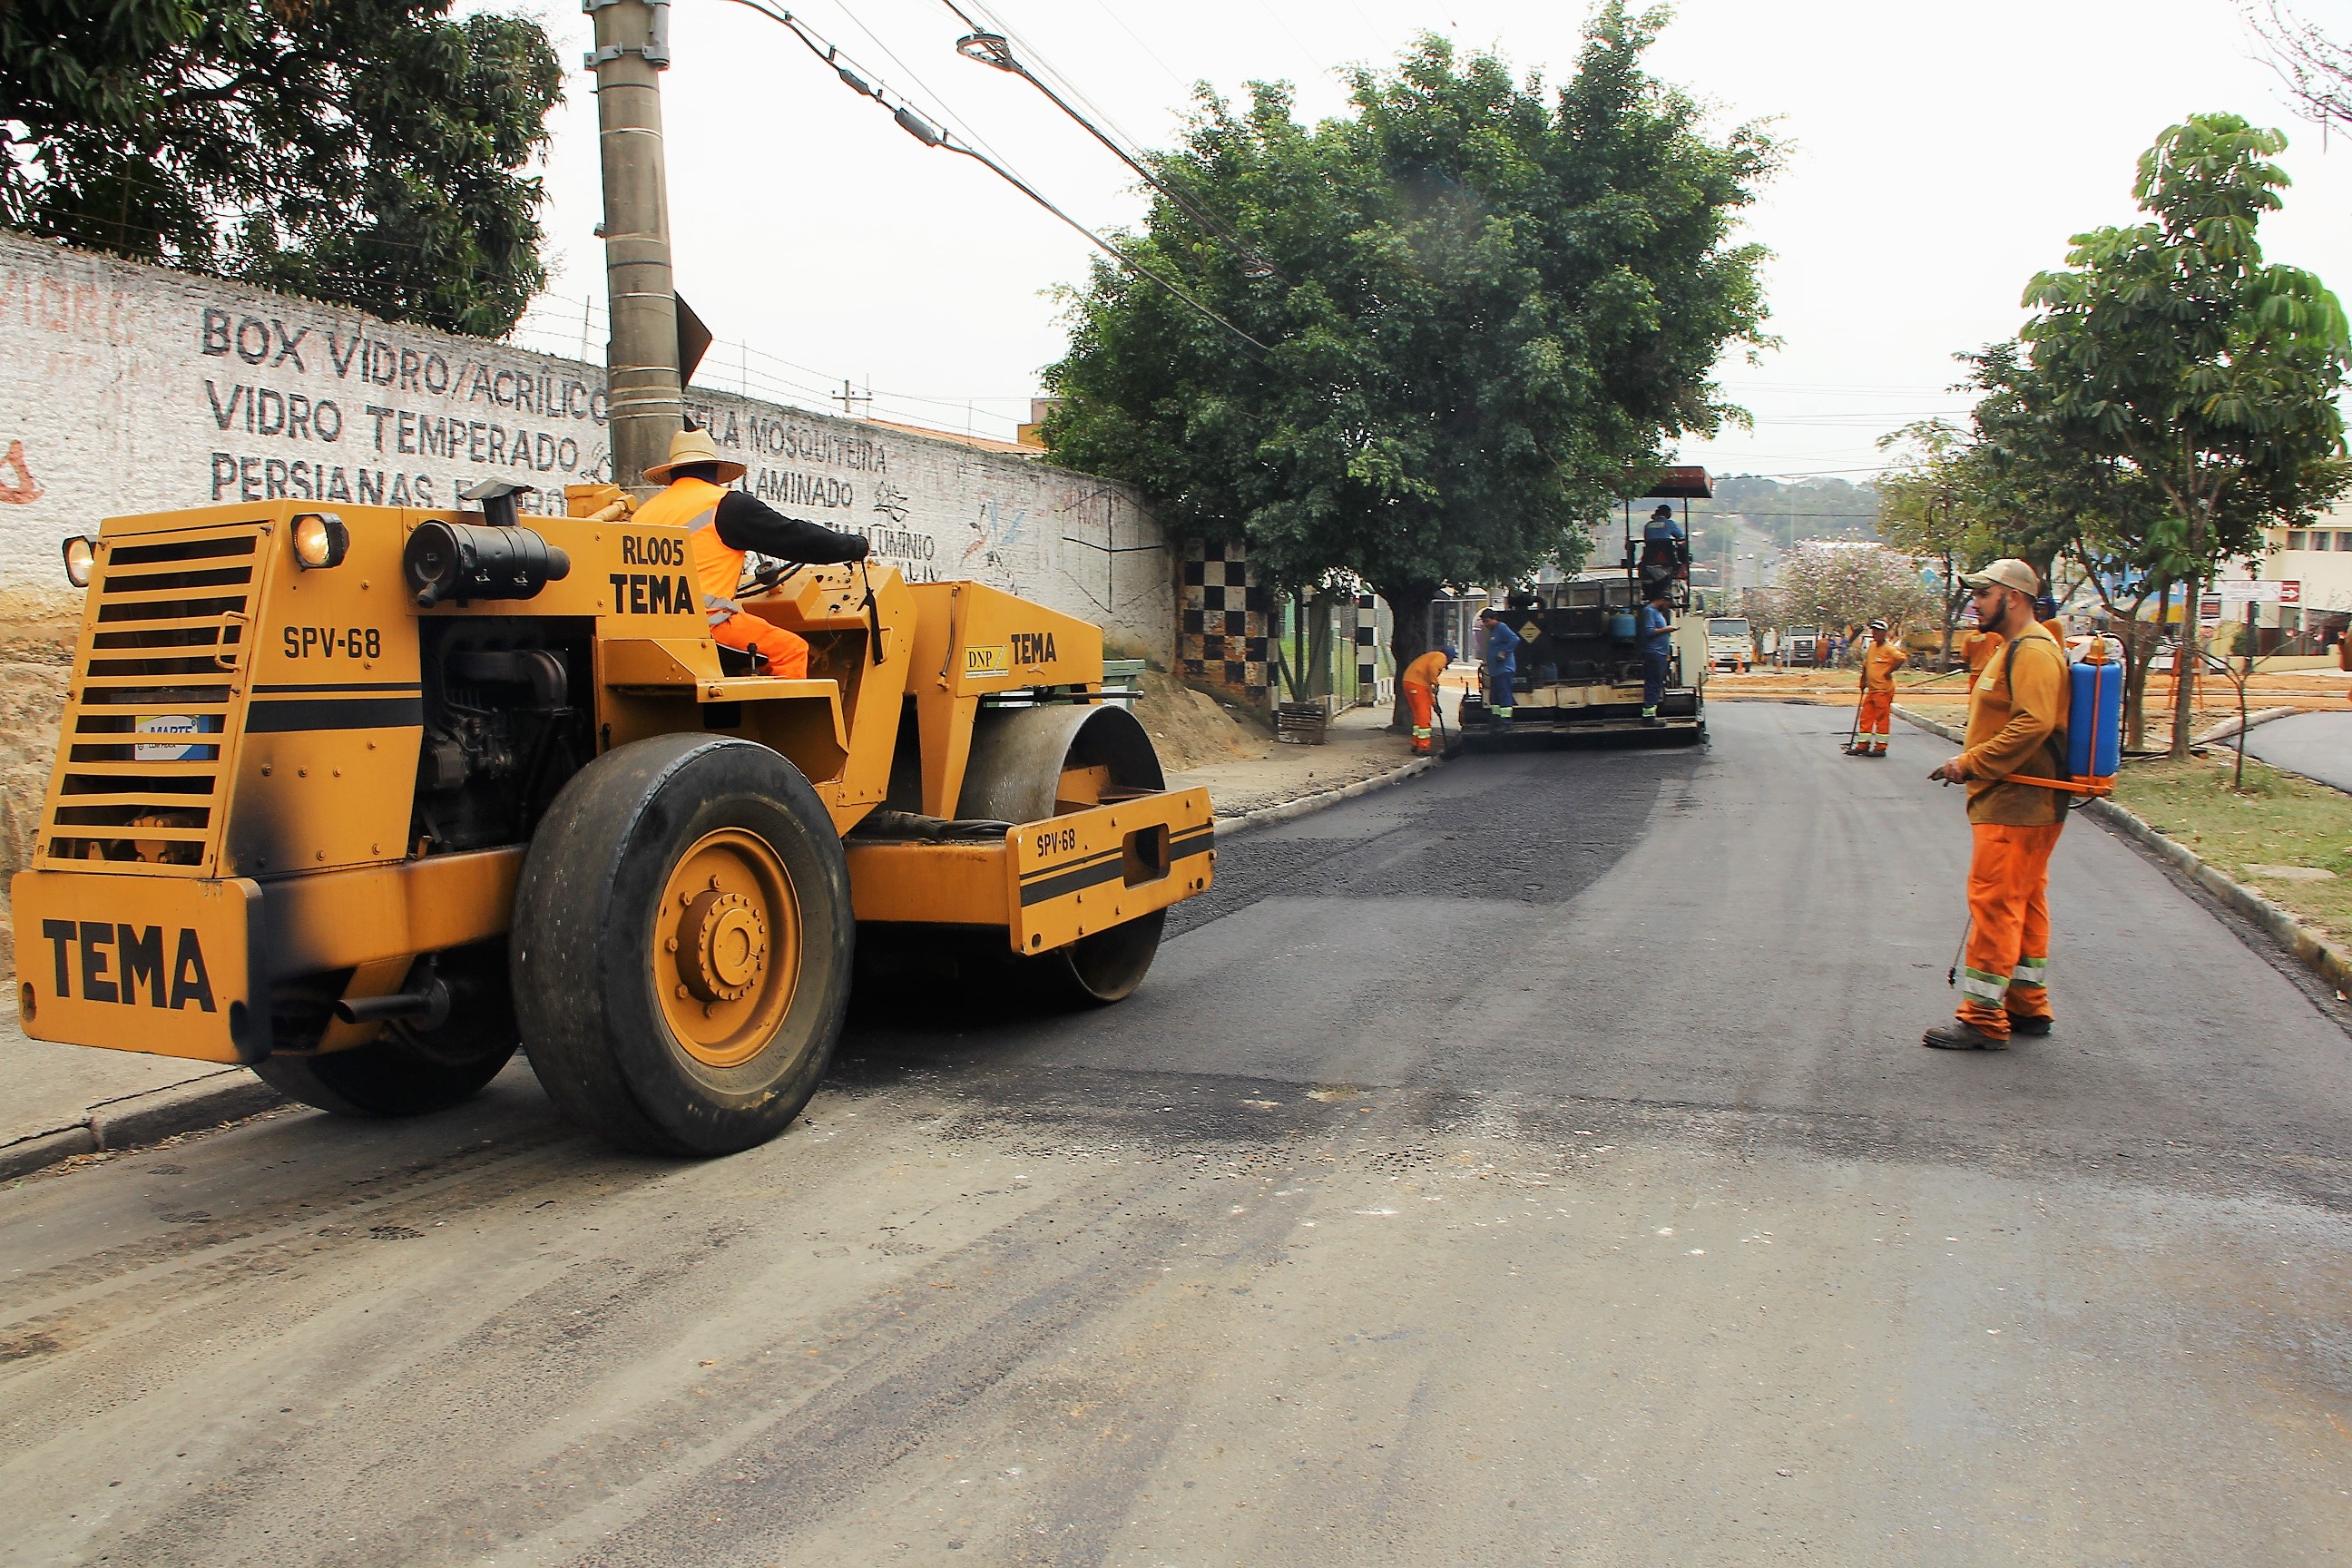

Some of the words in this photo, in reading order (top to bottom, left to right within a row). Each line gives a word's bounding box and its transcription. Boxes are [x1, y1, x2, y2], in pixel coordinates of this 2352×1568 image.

[202, 307, 311, 374] BOX
[750, 415, 887, 475] MOSQUITEIRA
[204, 378, 342, 443] VIDRO
[366, 404, 579, 473] TEMPERADO
[622, 534, 685, 567] RL005
[609, 573, 696, 615] TEMA
[283, 626, 381, 659] SPV-68
[1010, 632, 1057, 665] TEMA
[968, 651, 993, 668] DNP
[1036, 828, 1075, 858] SPV-68
[42, 918, 218, 1014] TEMA
